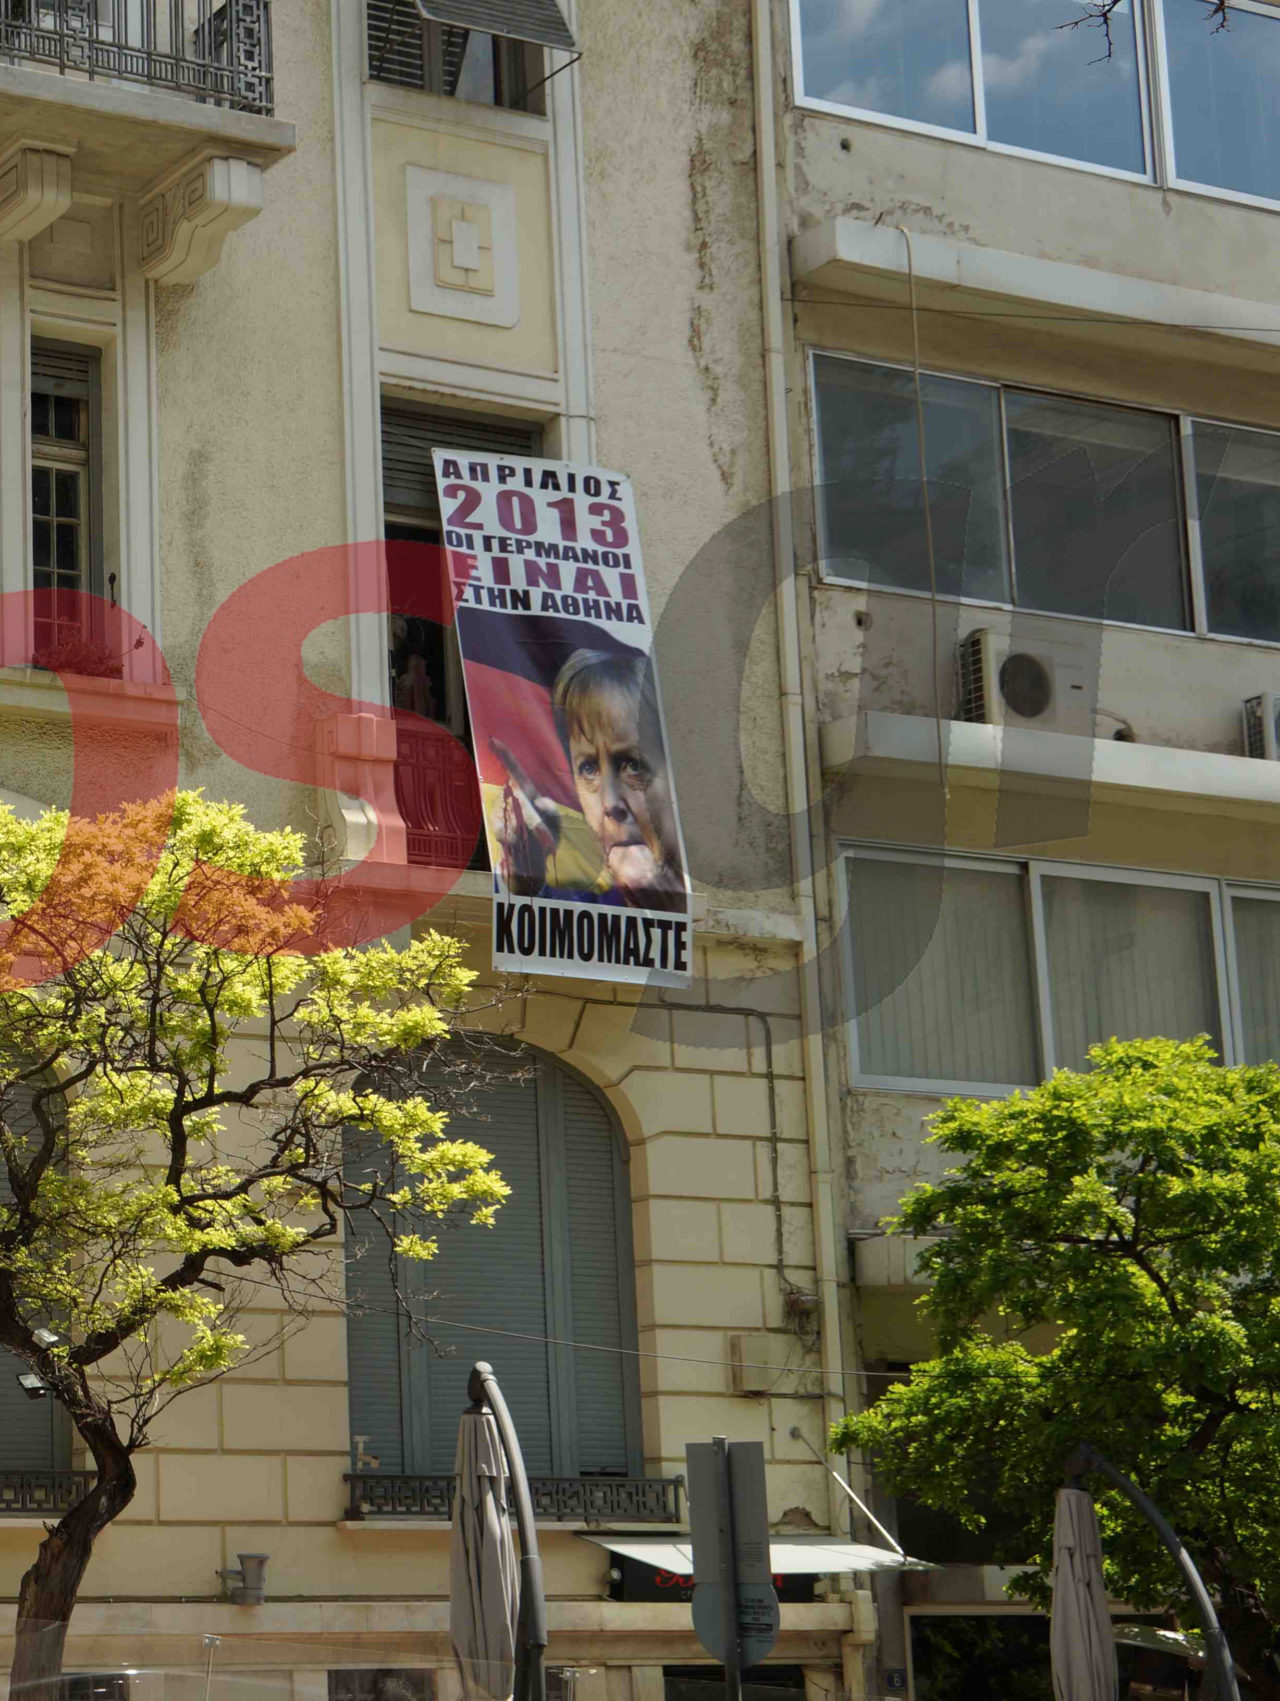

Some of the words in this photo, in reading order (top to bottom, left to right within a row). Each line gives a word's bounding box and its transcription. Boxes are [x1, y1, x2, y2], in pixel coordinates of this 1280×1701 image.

[442, 458, 623, 502] ΑΠΡΙΛΙΟΣ
[442, 483, 629, 550] 2013
[445, 530, 474, 551] ΟΙ
[483, 534, 632, 570] ΓΕΡΜΑΝΟΙ
[451, 550, 639, 601] ΕΙΝΑΙ
[452, 580, 531, 611] ΣΤΗΝ
[540, 591, 646, 625] ΑΘΗΝΑ
[495, 902, 688, 972] ΚΟΙΜΟΜΑΣΤΕ
